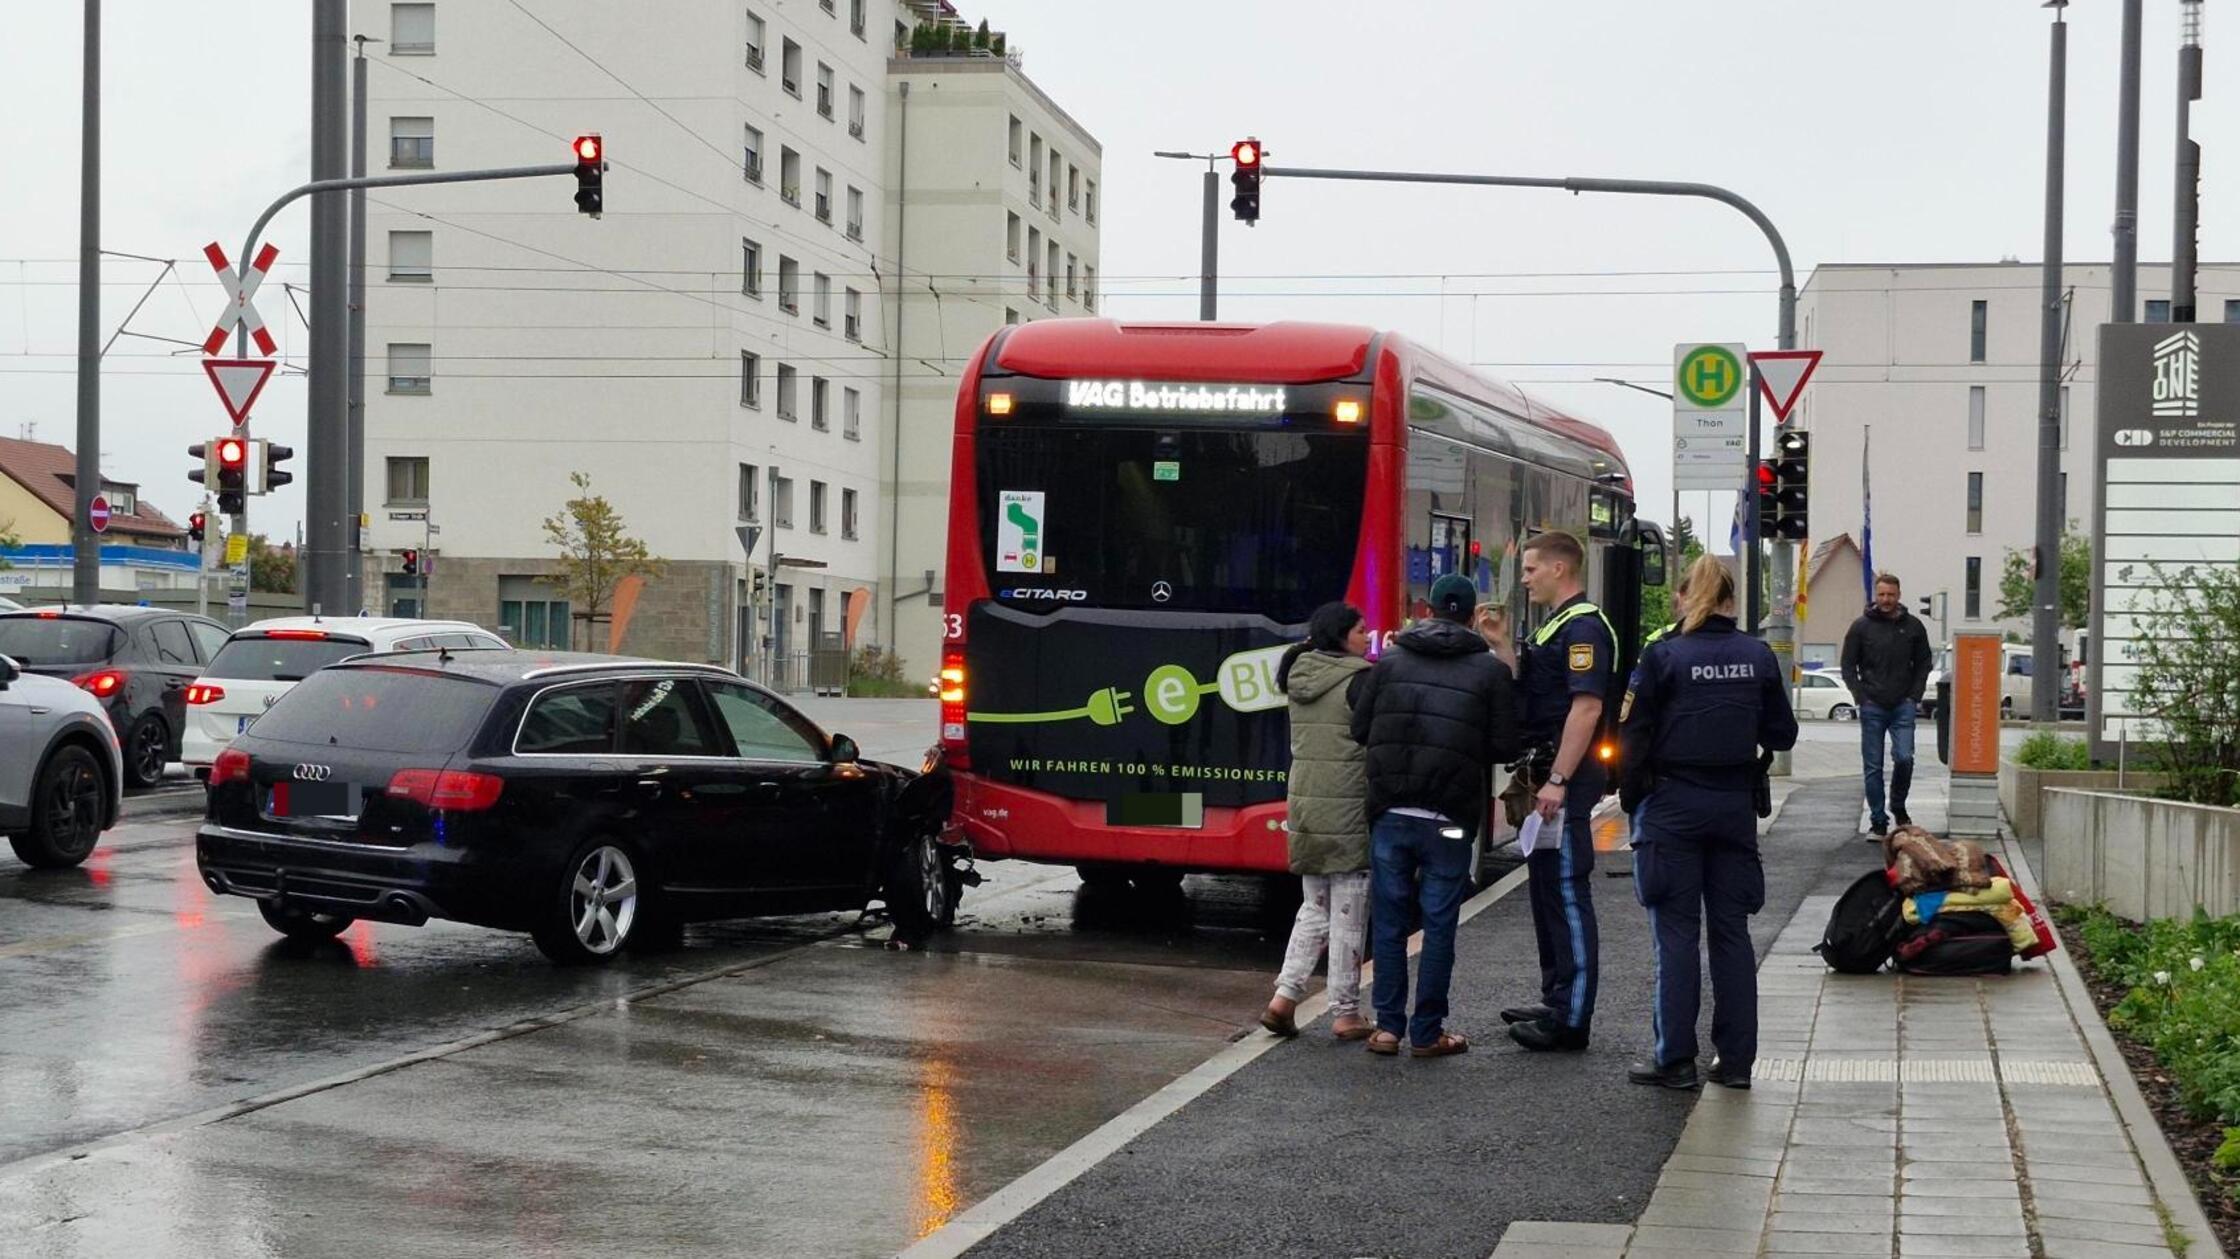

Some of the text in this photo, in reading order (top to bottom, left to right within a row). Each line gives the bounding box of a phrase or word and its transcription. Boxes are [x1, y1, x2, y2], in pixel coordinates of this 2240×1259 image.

[2153, 350, 2199, 379] THE
[1695, 360, 1725, 393] H
[2153, 376, 2199, 400] ONE
[1068, 381, 1287, 411] VAG Betriebsfahrt
[1696, 418, 1724, 428] Thon
[2178, 430, 2237, 438] COMMERCIAL
[2159, 438, 2237, 447] DEVELOPMENT
[1000, 588, 1088, 600] eCITARO
[1367, 629, 1399, 655] 16
[1691, 663, 1755, 680] POLIZEI
[1157, 676, 1186, 713] e
[1009, 759, 1287, 782] WIR FAHREN 100 % EMISSIONSFR
